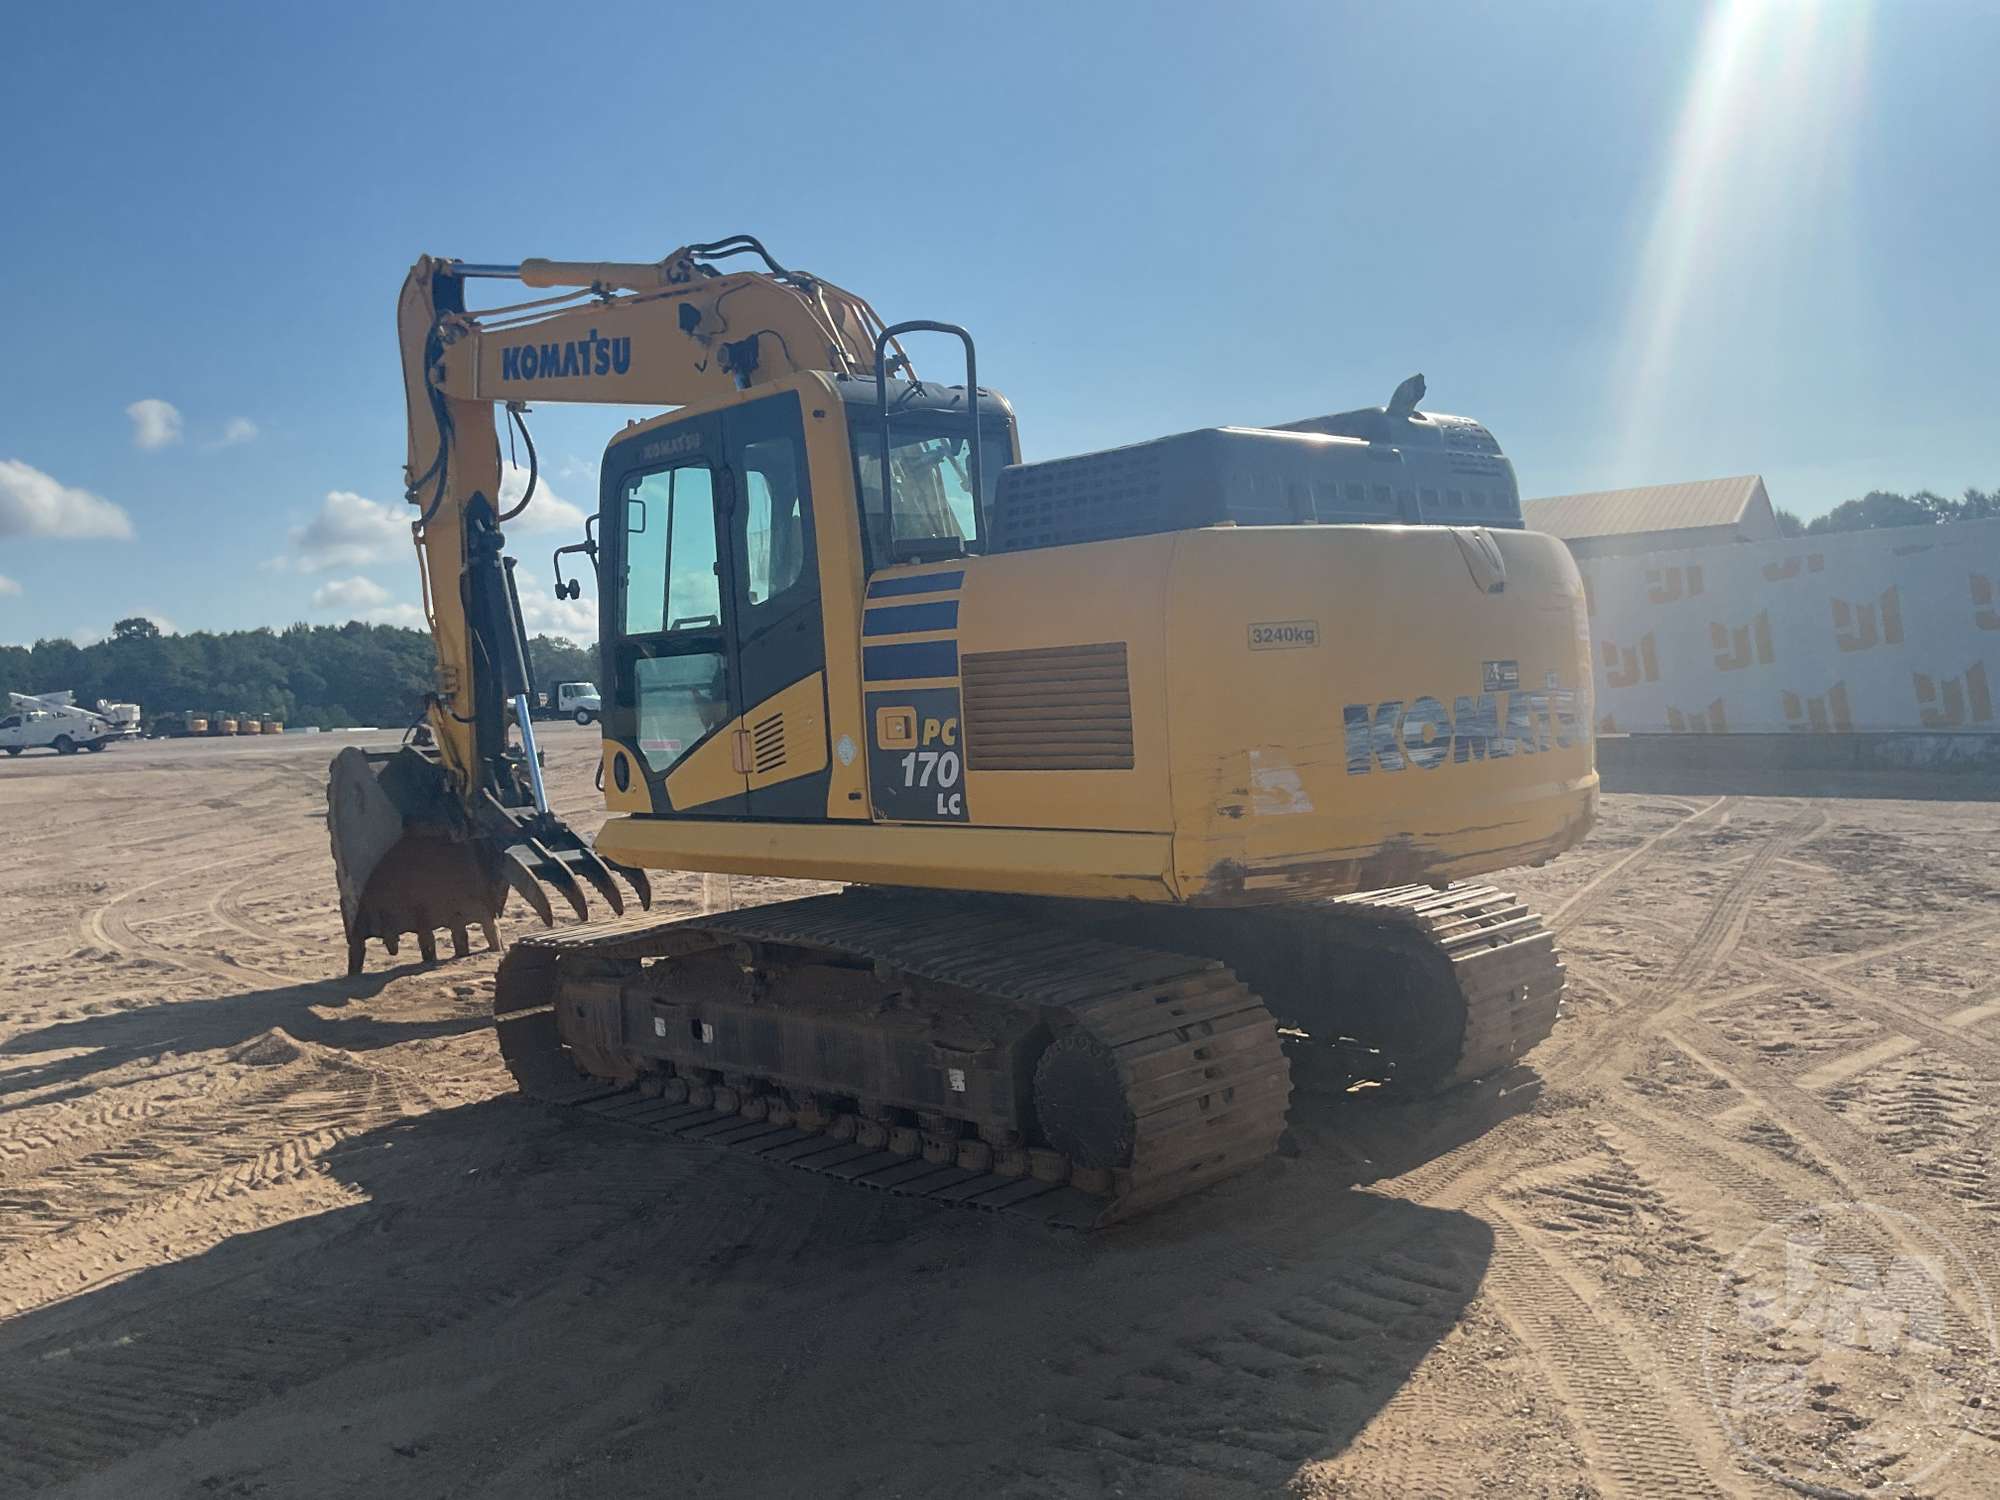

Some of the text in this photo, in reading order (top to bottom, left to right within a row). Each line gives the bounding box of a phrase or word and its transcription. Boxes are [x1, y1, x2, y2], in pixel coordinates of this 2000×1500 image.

[503, 329, 631, 381] KOMATSU
[642, 432, 700, 459] KOMATSU
[1252, 626, 1315, 646] 3240kg
[923, 718, 957, 746] PC
[901, 750, 960, 788] 170
[936, 793, 961, 816] LC
